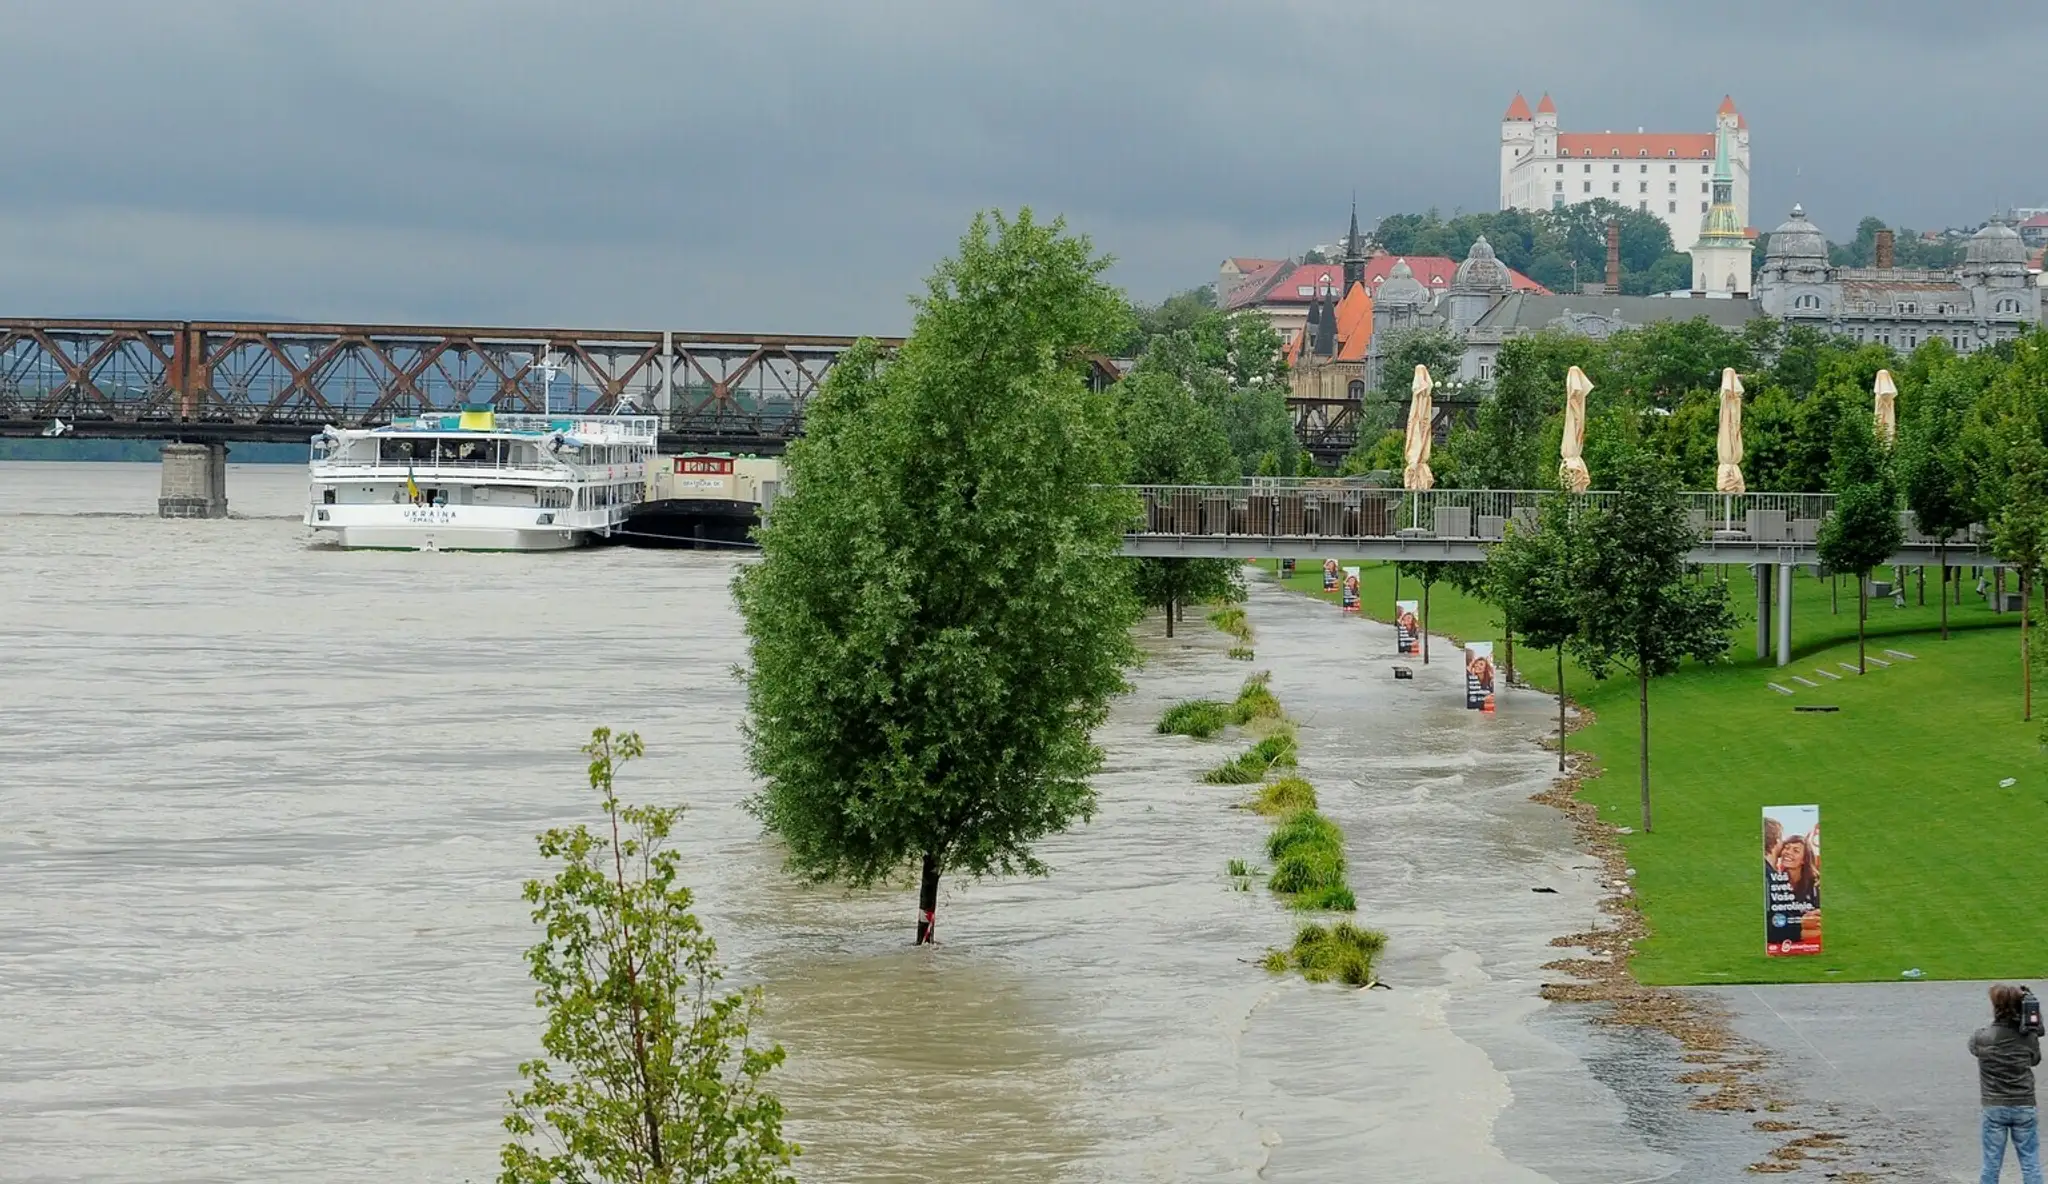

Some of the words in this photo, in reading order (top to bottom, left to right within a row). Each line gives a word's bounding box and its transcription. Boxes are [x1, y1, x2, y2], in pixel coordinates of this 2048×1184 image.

[404, 510, 456, 518] UKRAINA
[1770, 872, 1789, 881] Váš
[1771, 883, 1793, 891] svet.
[1771, 892, 1795, 901] Vaše
